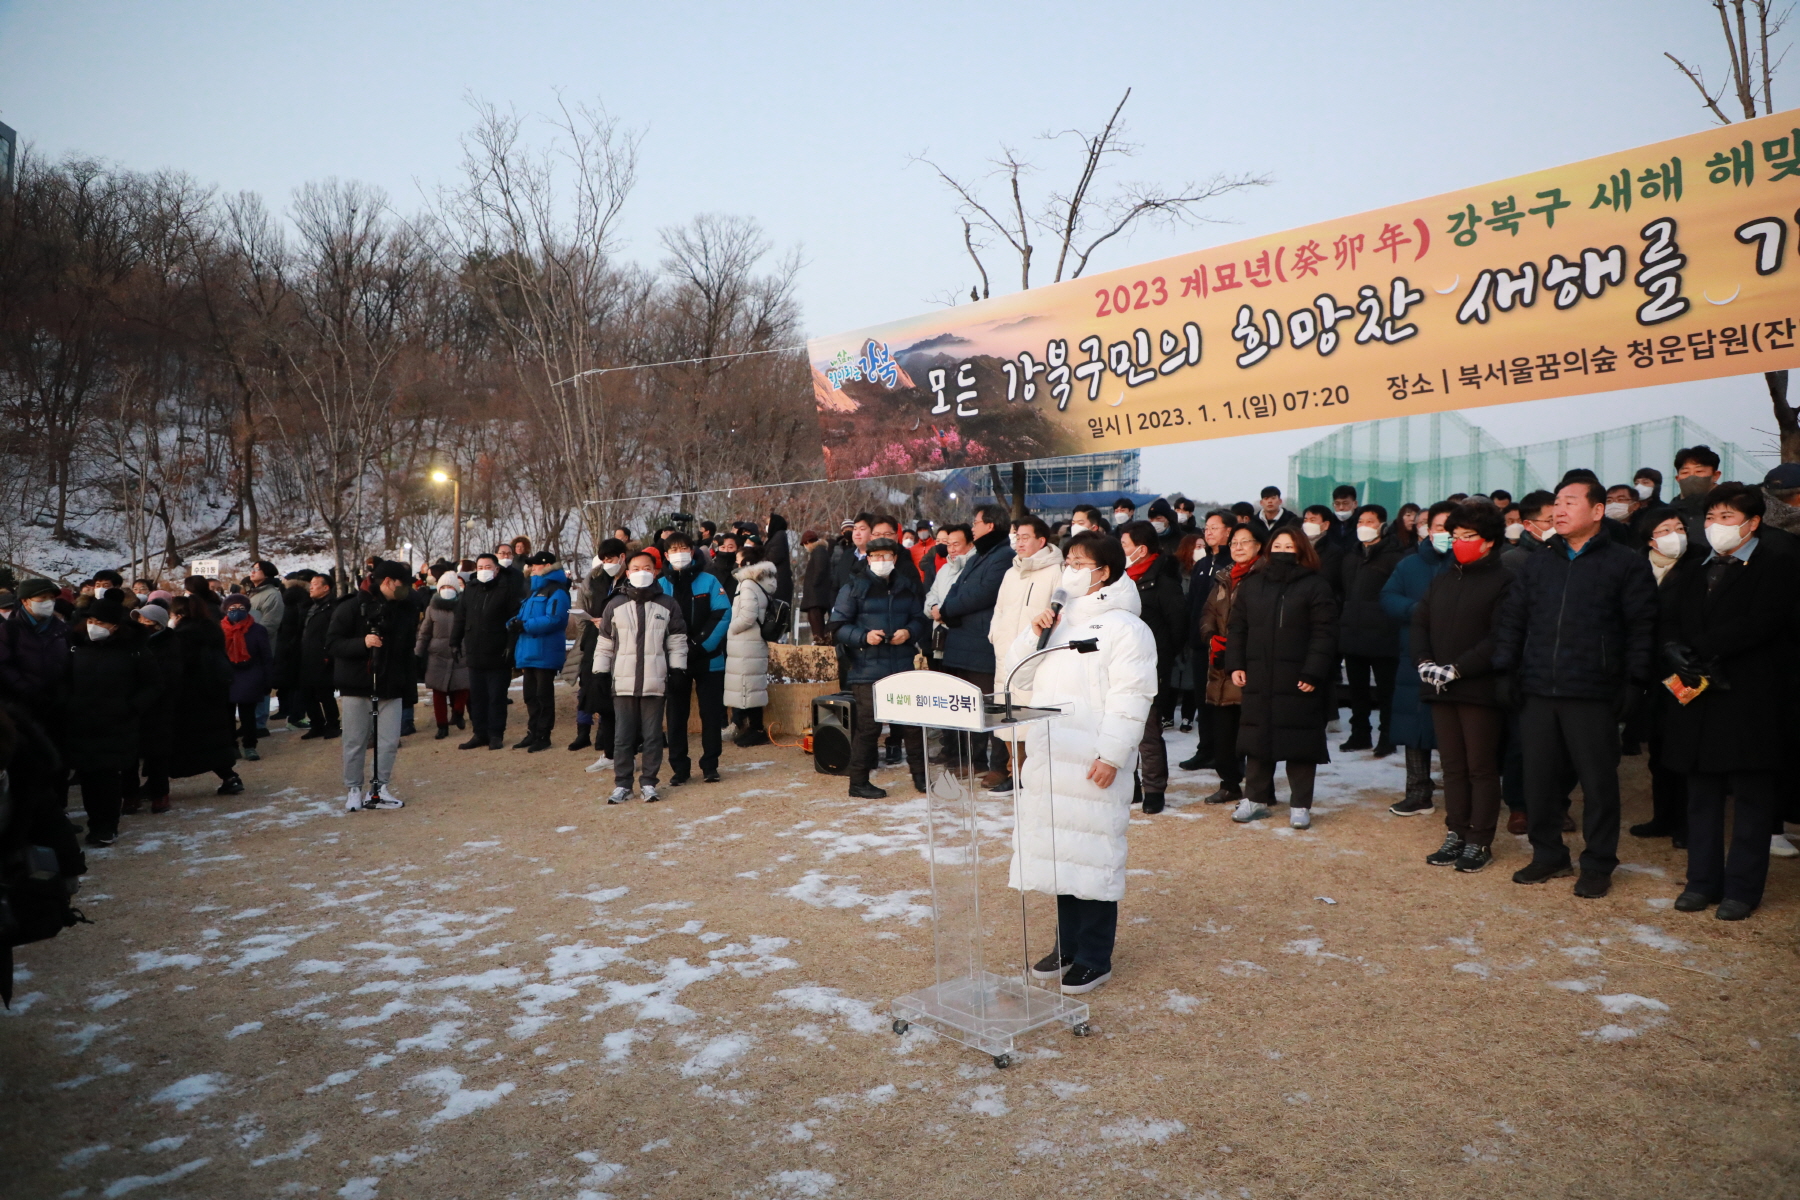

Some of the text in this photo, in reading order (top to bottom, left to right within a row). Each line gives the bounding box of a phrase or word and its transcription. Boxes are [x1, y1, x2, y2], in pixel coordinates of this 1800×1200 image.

[927, 363, 980, 417] 모든
[1002, 322, 1202, 411] 강북구민의
[1232, 276, 1424, 369] 희망찬
[1456, 217, 1690, 325] 새해를
[1095, 276, 1169, 318] 2023
[1180, 218, 1430, 299] 계묘년(癸卯年)
[1446, 188, 1571, 247] 강북구
[1588, 157, 1683, 212] 새해
[1087, 414, 1121, 438] 일시
[1137, 408, 1192, 431] 2023.
[1283, 385, 1350, 411] 07:20
[1386, 373, 1435, 401] 장소
[1458, 345, 1618, 390] 북서울꿈의숲
